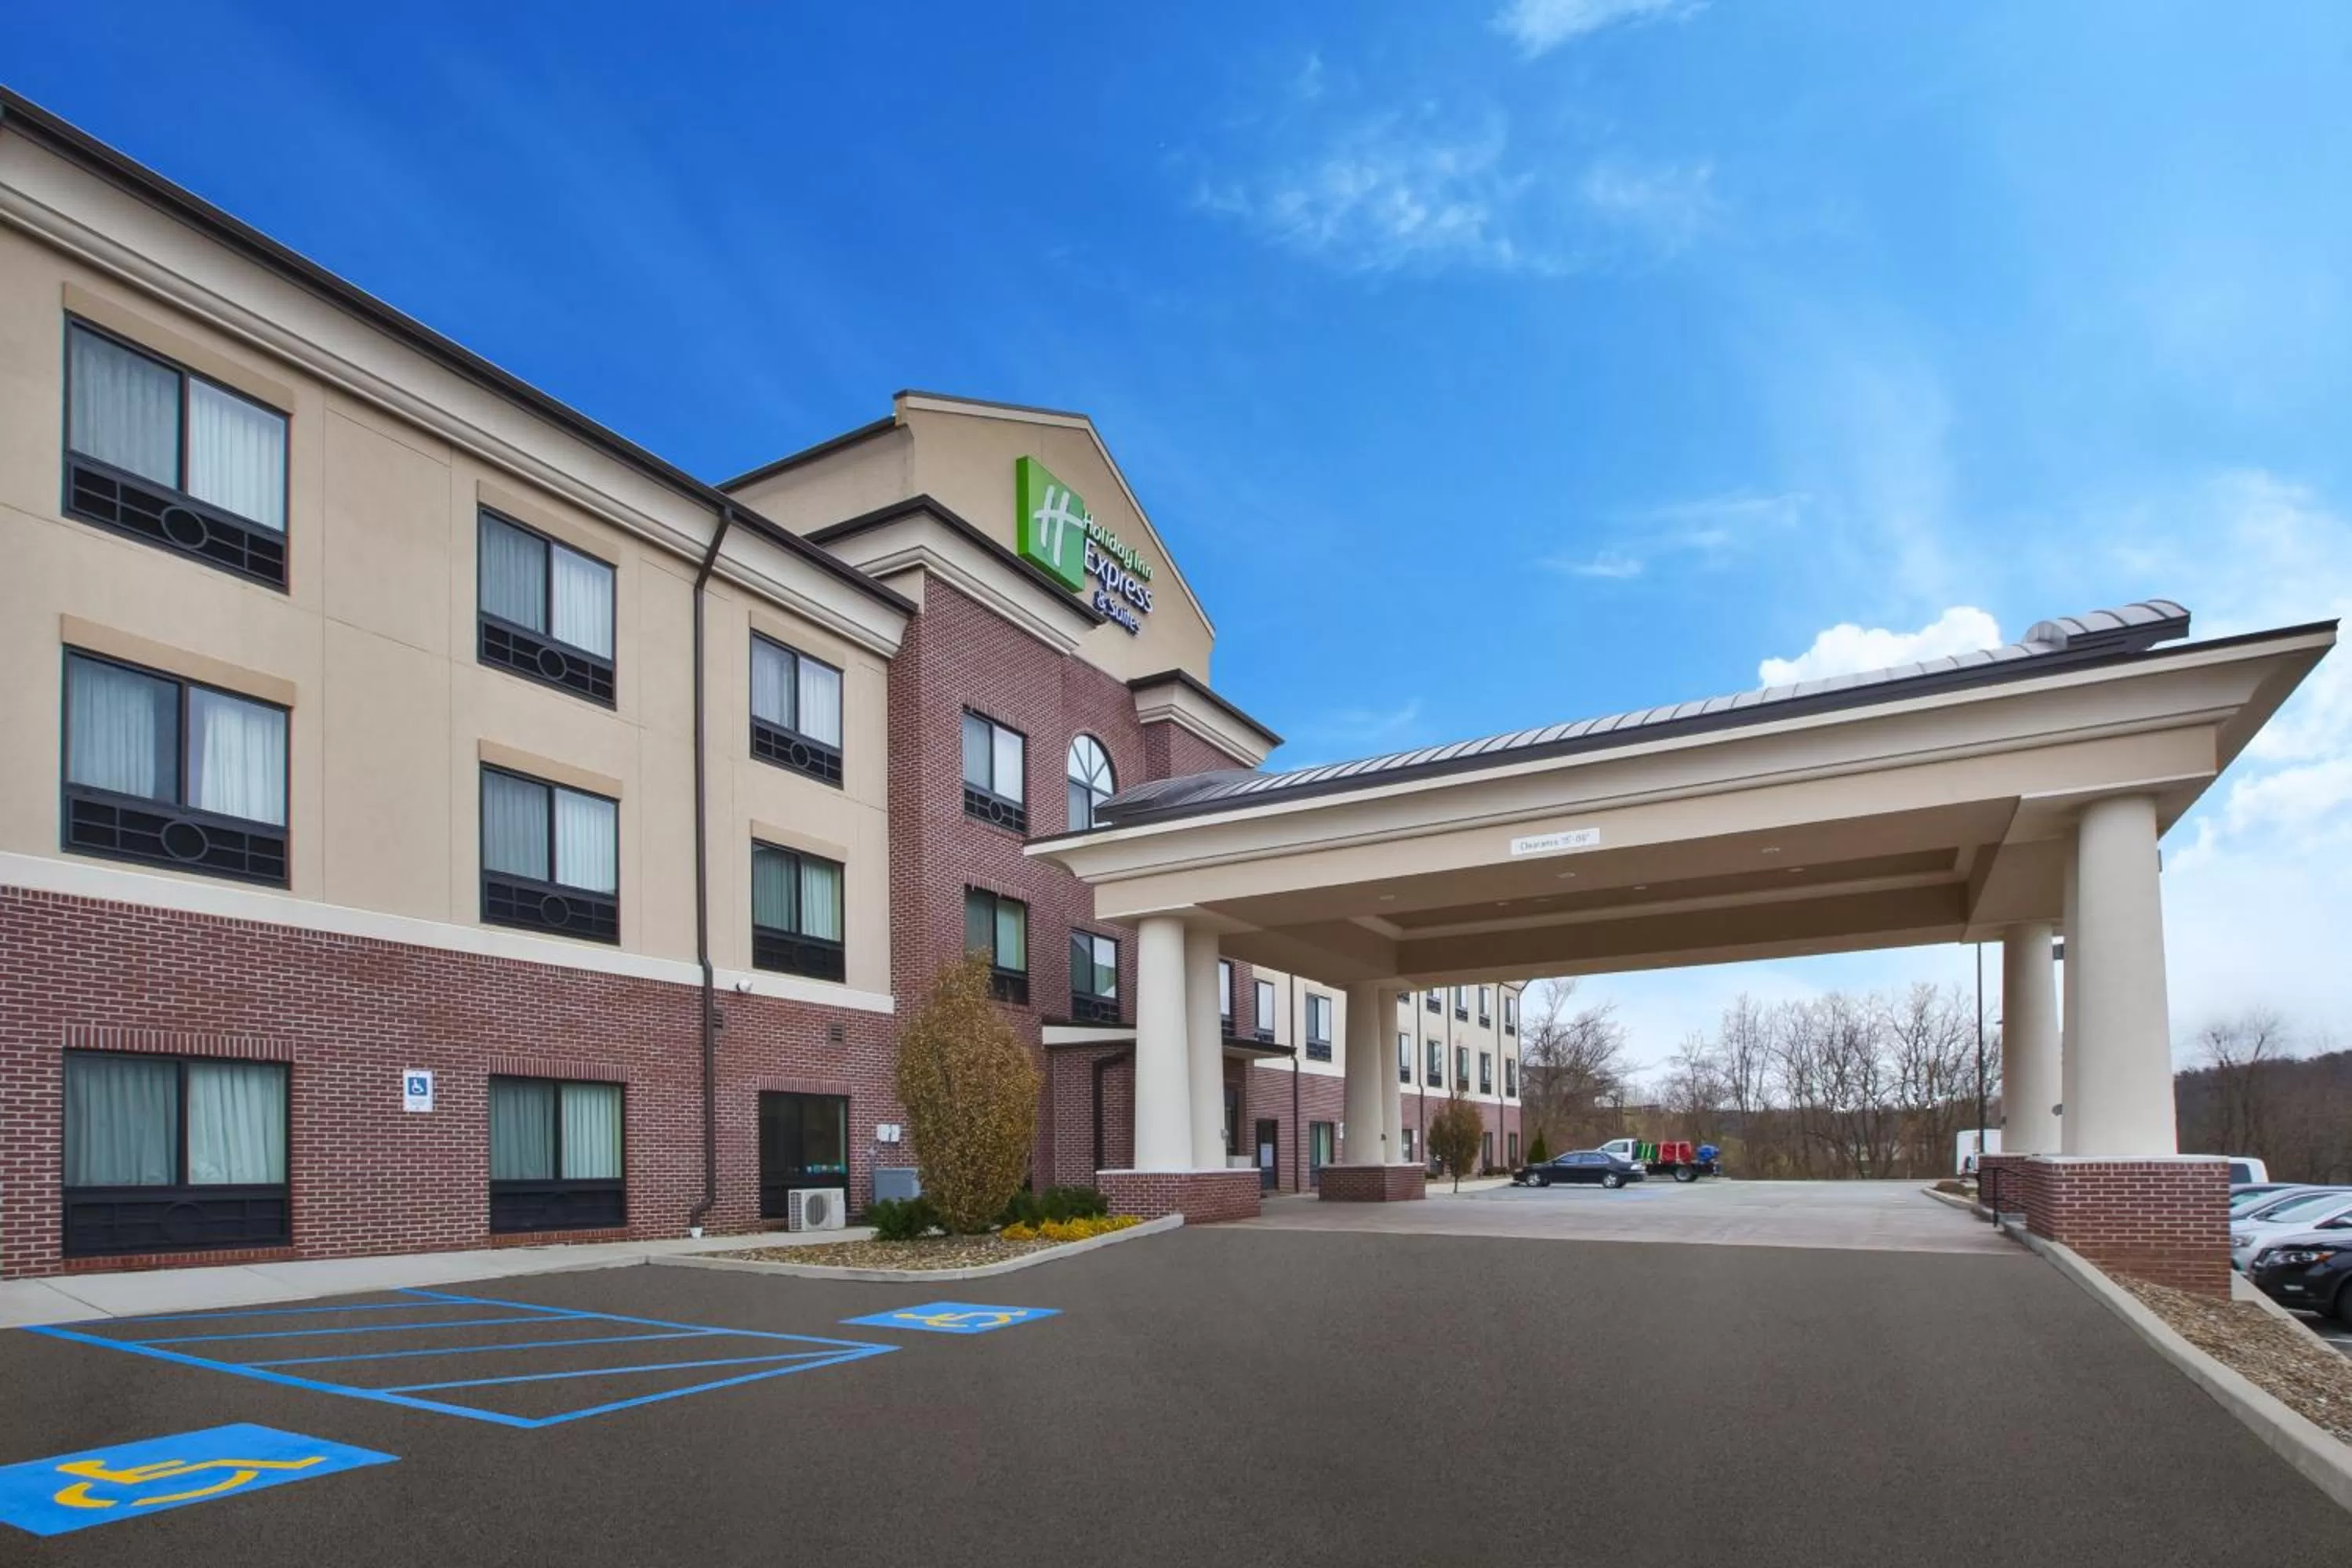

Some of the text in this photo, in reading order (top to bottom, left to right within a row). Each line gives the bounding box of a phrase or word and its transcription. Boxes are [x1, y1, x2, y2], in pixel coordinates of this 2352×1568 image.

[1083, 510, 1153, 580] Holiday Inn
[1084, 537, 1153, 612] Express
[1096, 590, 1142, 634] & Suites
